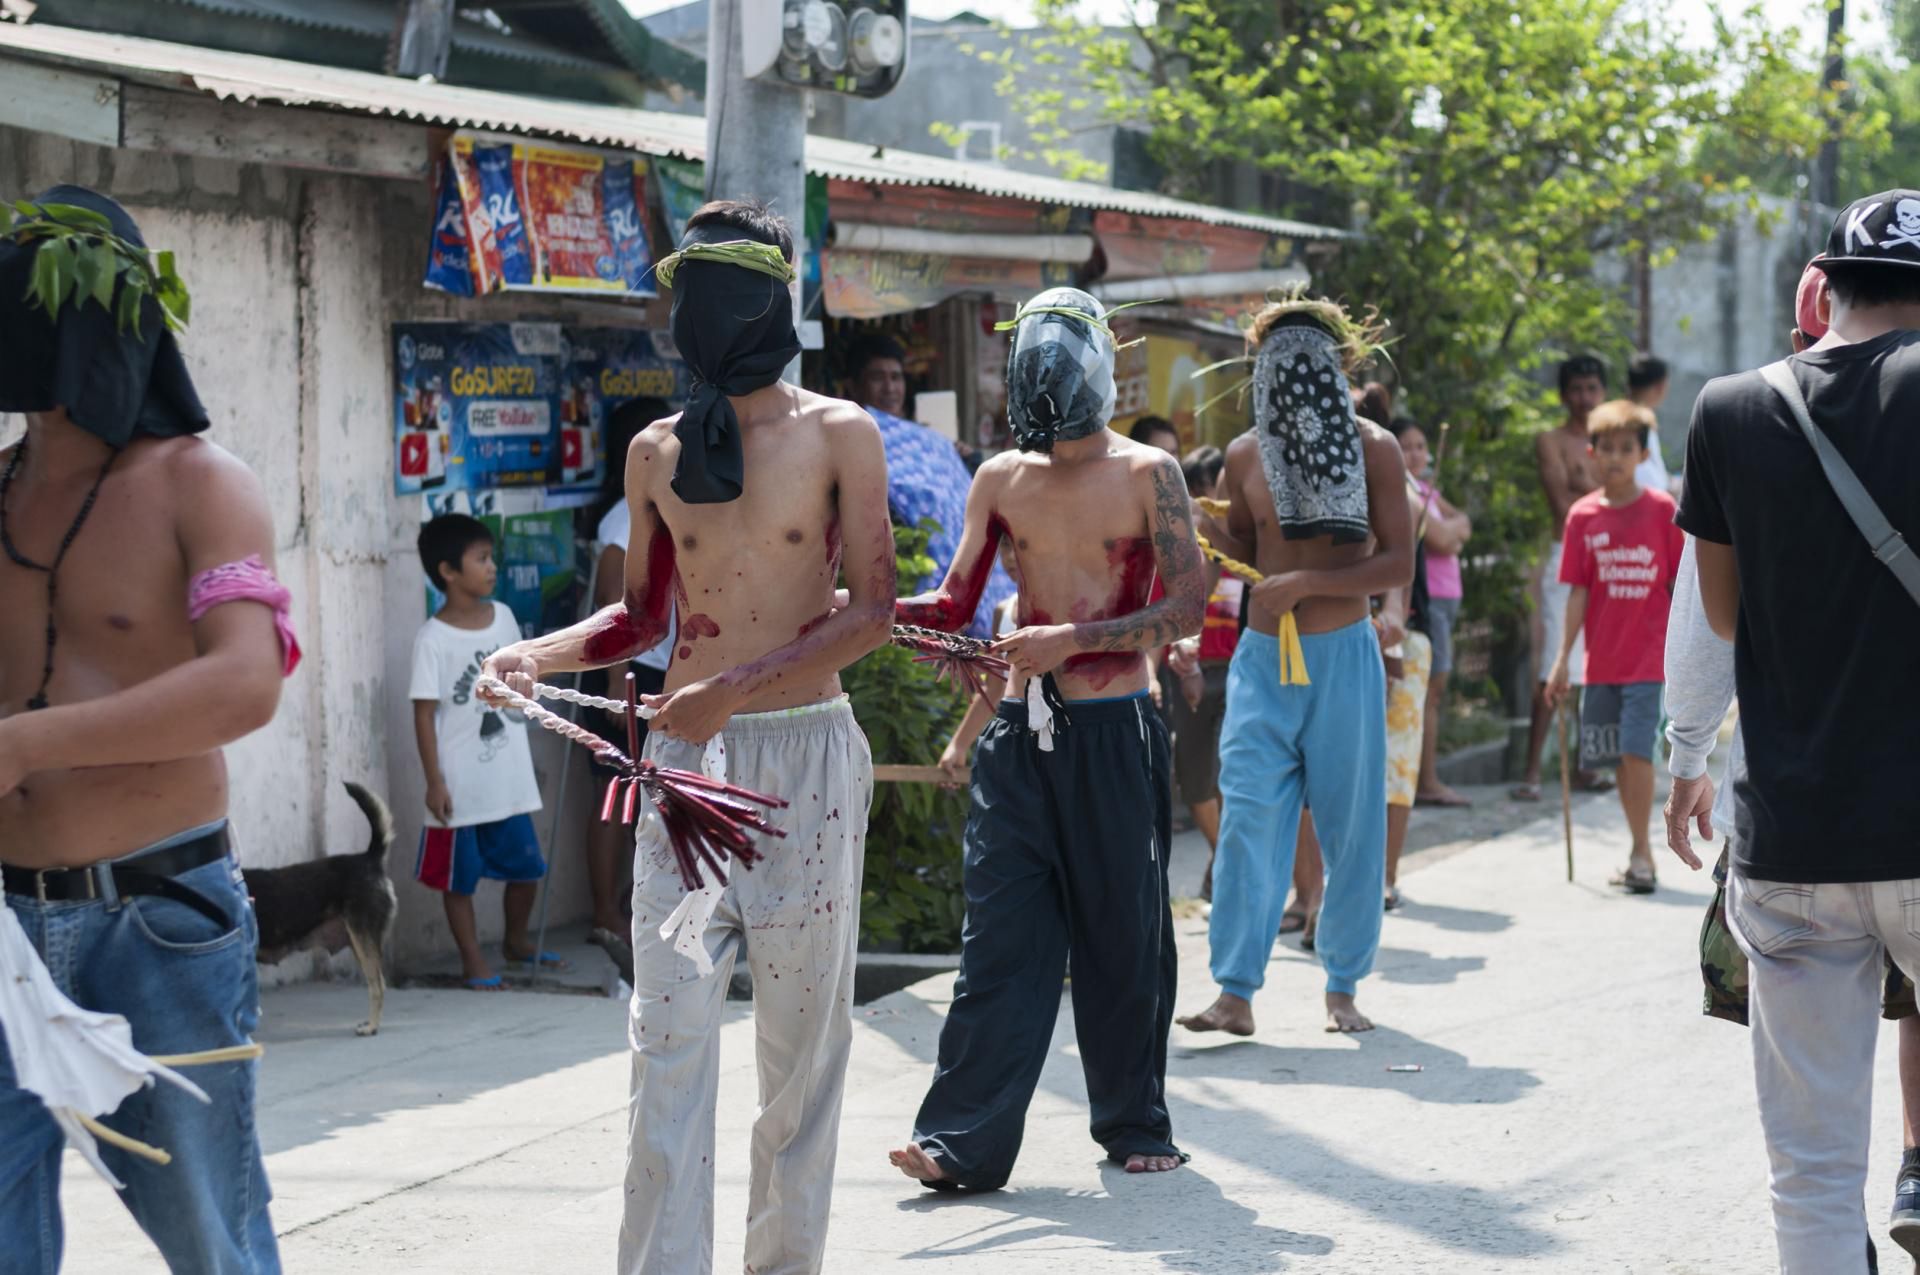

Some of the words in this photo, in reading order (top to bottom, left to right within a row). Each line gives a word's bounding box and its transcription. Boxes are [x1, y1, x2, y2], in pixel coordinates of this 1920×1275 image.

[1844, 202, 1883, 255] K
[418, 342, 445, 361] Globe
[451, 366, 536, 397] GoSURF50
[471, 408, 497, 429] FREE
